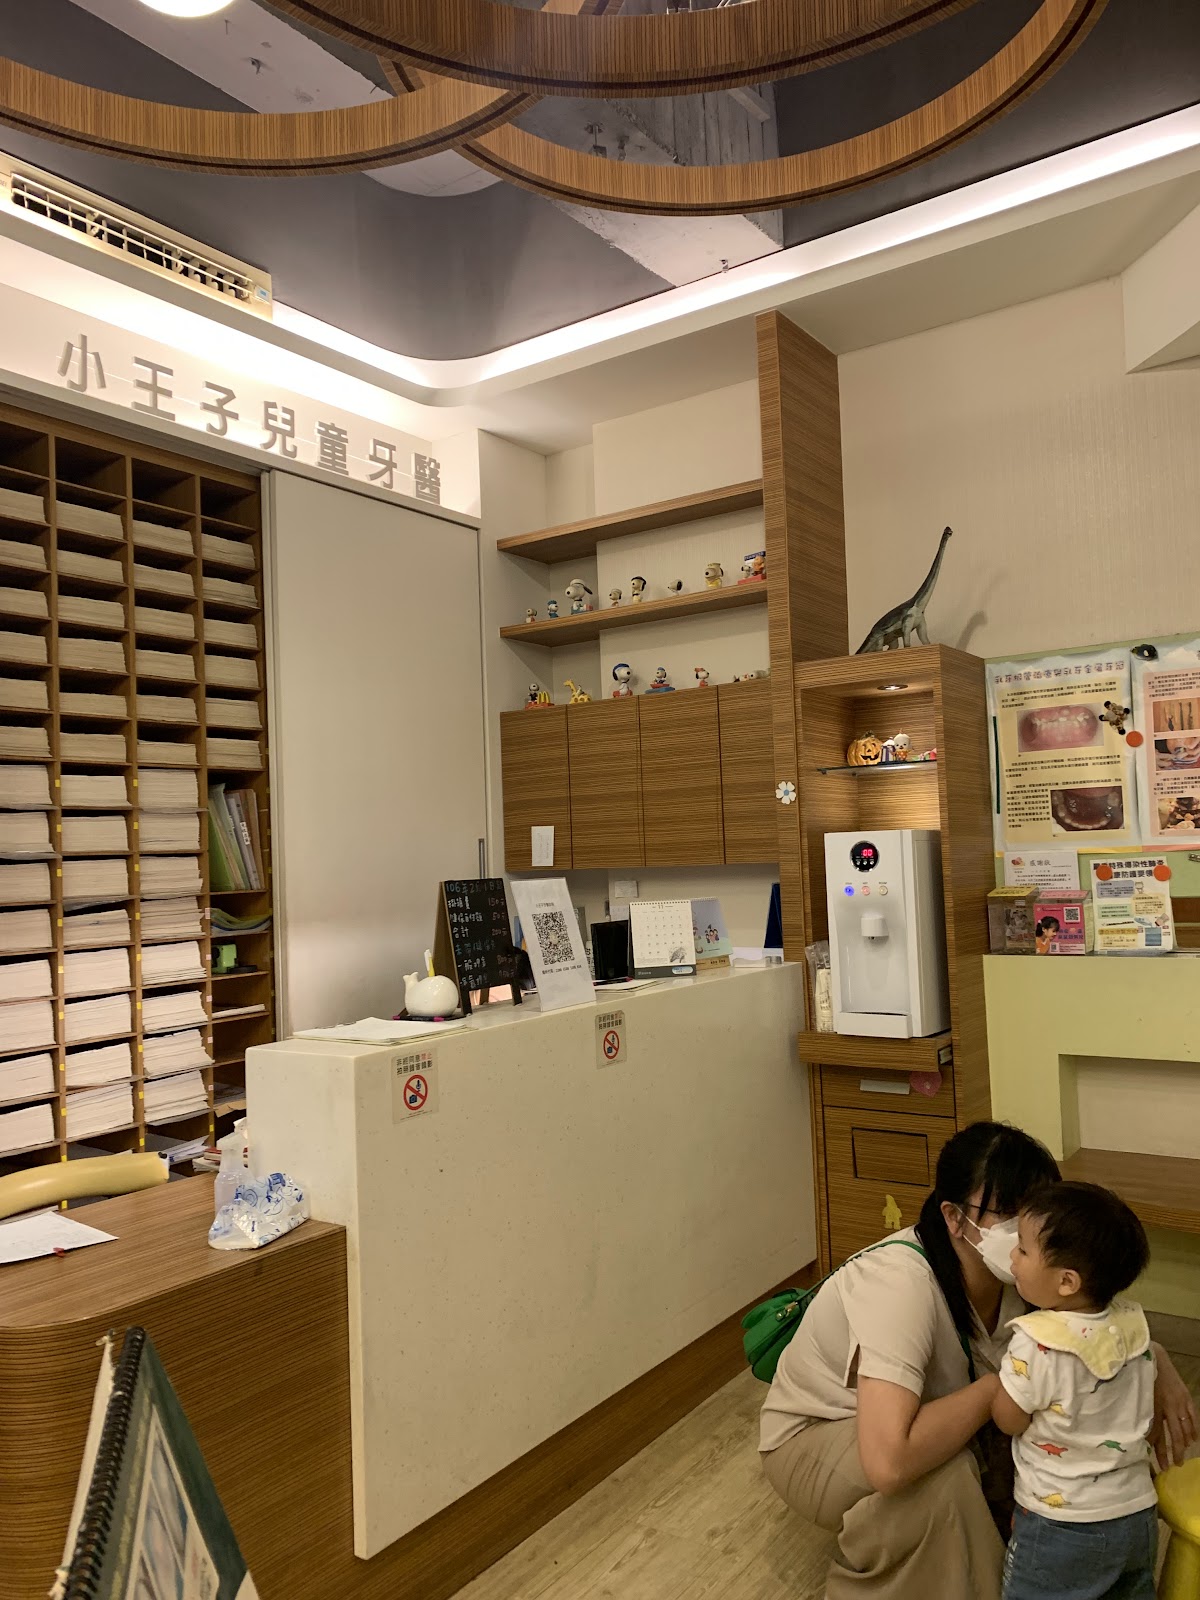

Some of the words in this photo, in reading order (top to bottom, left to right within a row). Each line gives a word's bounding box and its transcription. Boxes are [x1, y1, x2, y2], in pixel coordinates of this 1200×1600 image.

[56, 333, 441, 505] 小王子兒童牙醫
[1093, 859, 1164, 871] 嚴特殊傳染性肺炎
[1110, 869, 1153, 880] 康防護要領
[453, 926, 469, 939] 合計
